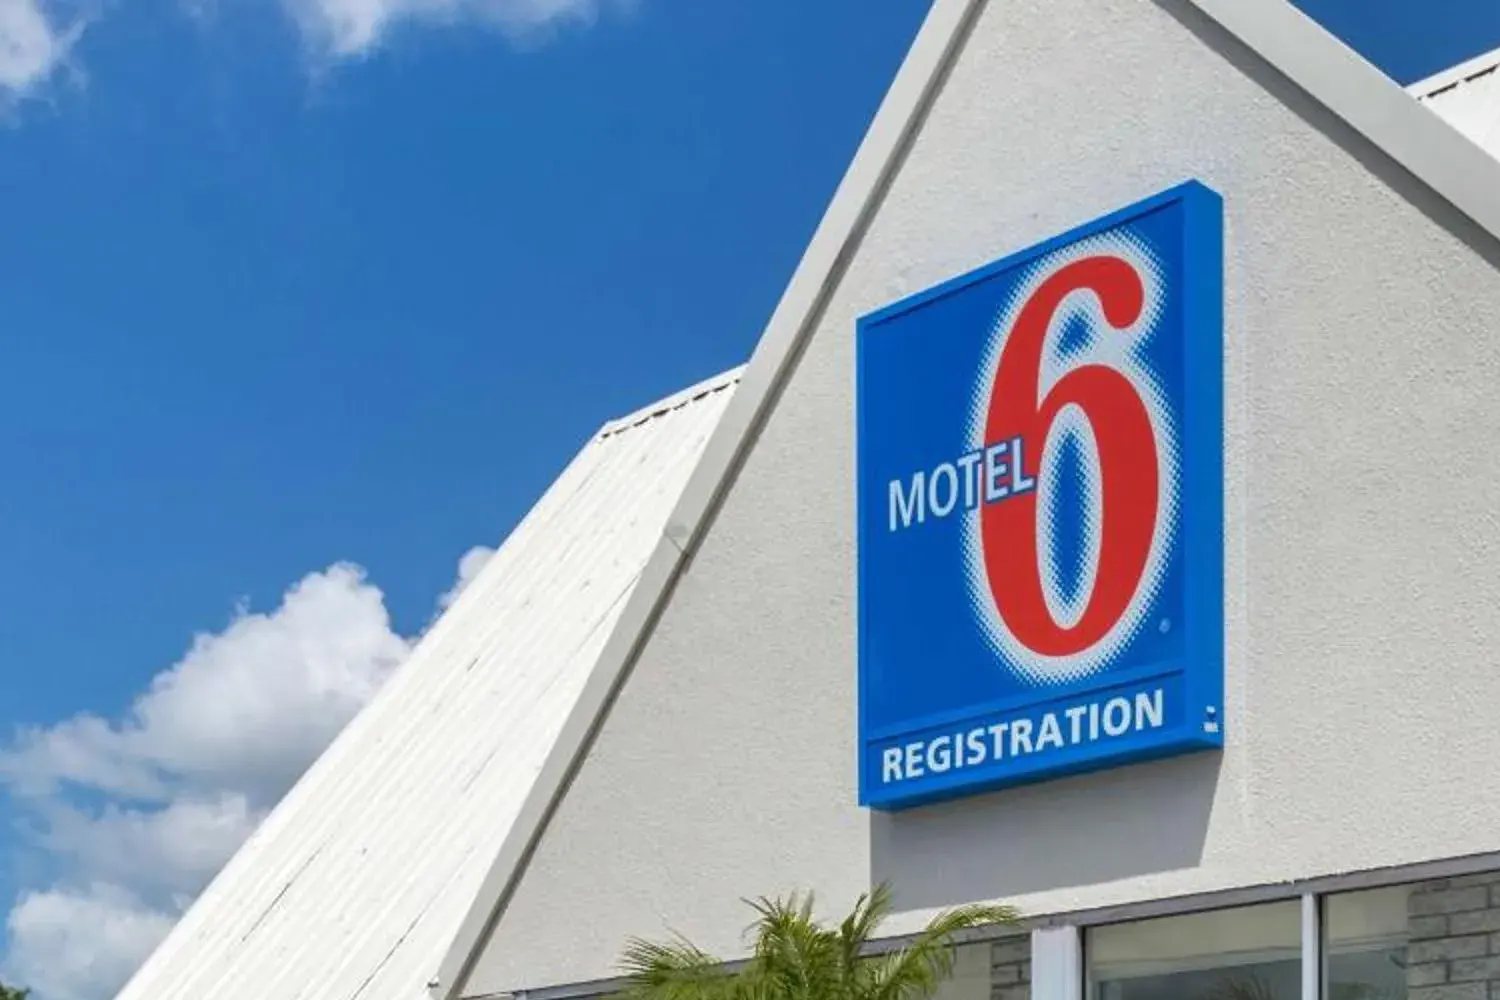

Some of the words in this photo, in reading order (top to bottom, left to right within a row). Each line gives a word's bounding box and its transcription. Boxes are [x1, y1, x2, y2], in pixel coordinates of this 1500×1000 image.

[888, 437, 1036, 532] MOTEL
[980, 255, 1159, 657] 6
[882, 690, 1164, 783] REGISTRATION
